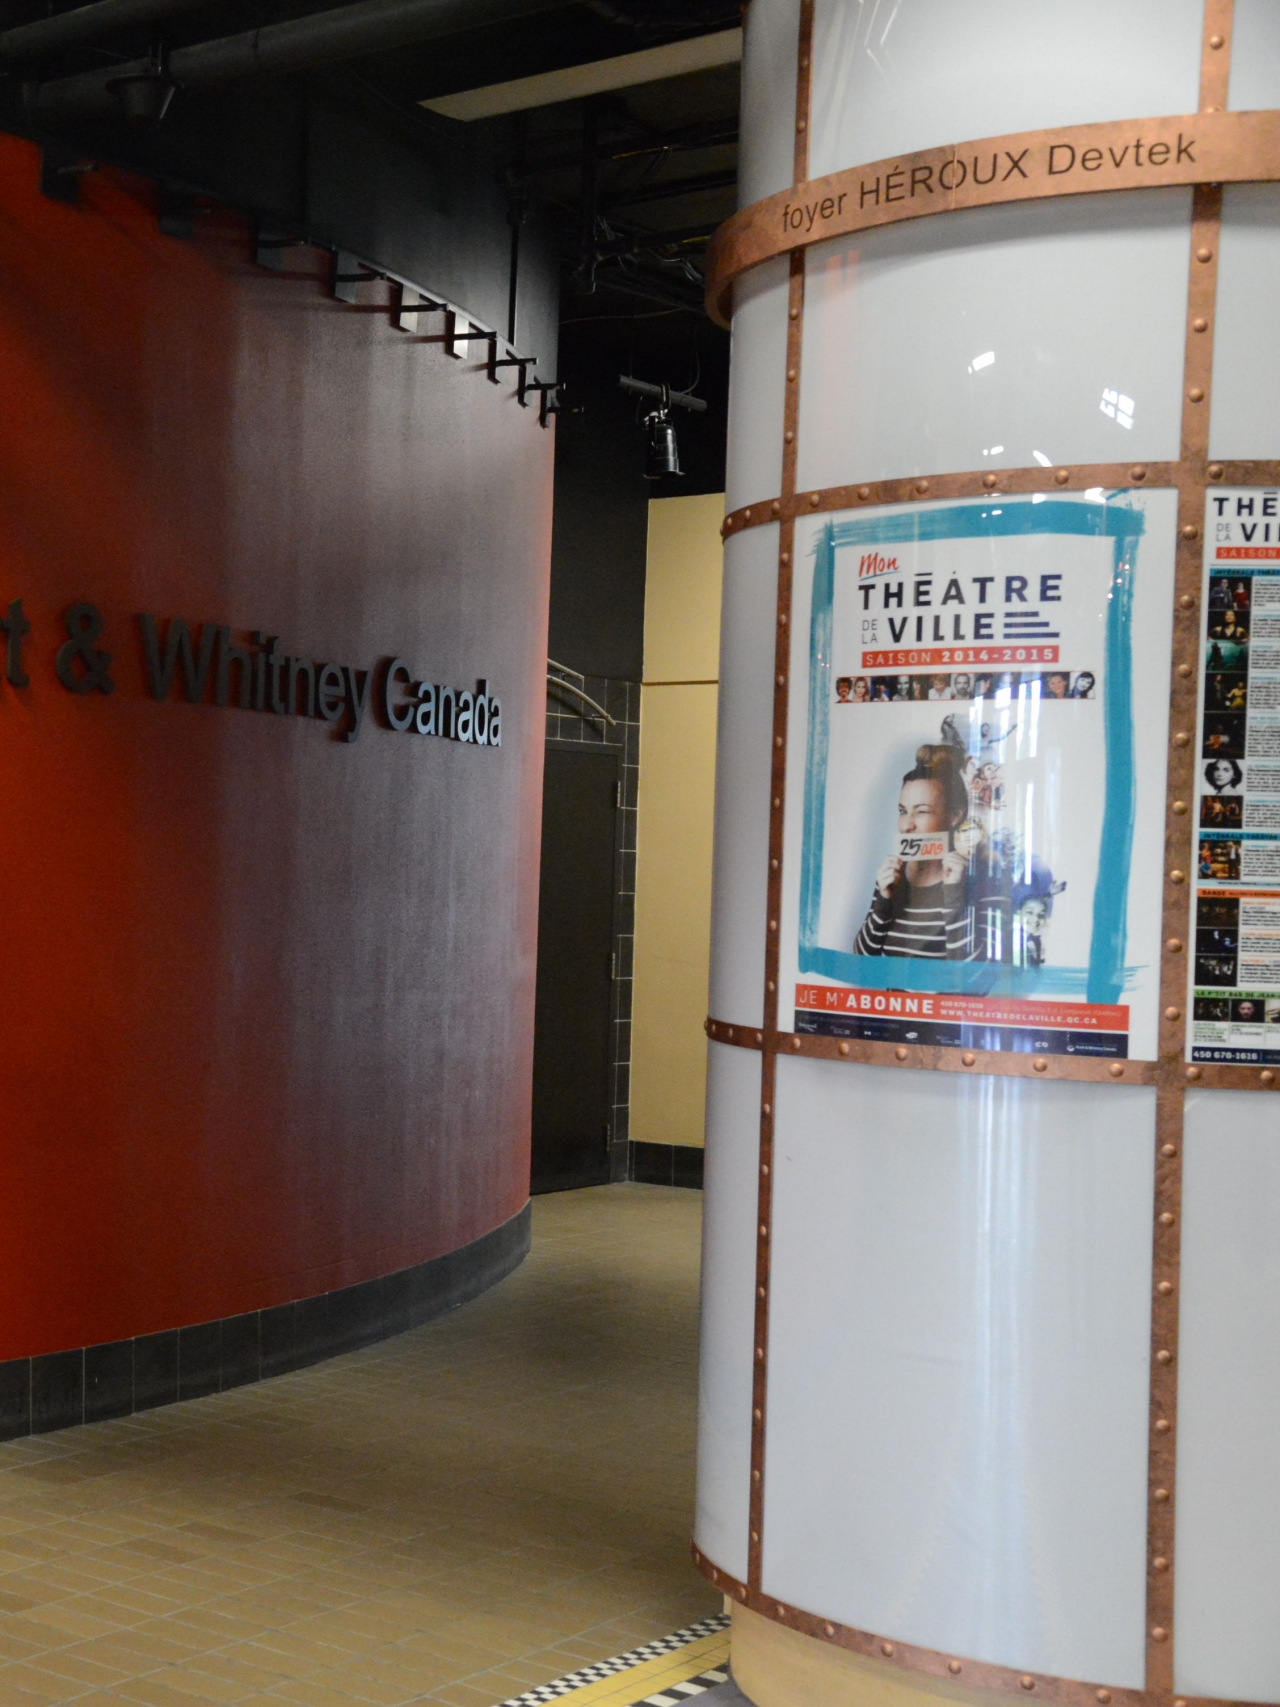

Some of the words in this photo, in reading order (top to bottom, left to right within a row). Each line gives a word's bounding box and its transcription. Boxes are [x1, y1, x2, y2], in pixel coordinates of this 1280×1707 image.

[782, 193, 848, 233] foyer
[859, 149, 1030, 210] HÉROUX
[1048, 133, 1197, 177] Devtek
[1217, 523, 1231, 532] DE
[1216, 533, 1231, 542] LA
[1220, 547, 1276, 558] SAISON
[858, 552, 899, 577] Mon
[862, 619, 878, 631] DE
[888, 612, 995, 643] VILLE
[862, 633, 878, 644] LA
[865, 652, 932, 666] SAISON
[941, 648, 1054, 662] 2014-2015
[54, 601, 116, 696] &
[134, 612, 376, 744] Whitney
[377, 655, 503, 748] Canada
[900, 838, 923, 857] 25
[921, 842, 945, 856] ans
[799, 990, 818, 1005] JE
[940, 1009, 1098, 1025] WWW.THEATREDELAVILLE.QC.CA
[1193, 1050, 1212, 1059] 450
[1213, 1051, 1258, 1060] 670-1616
